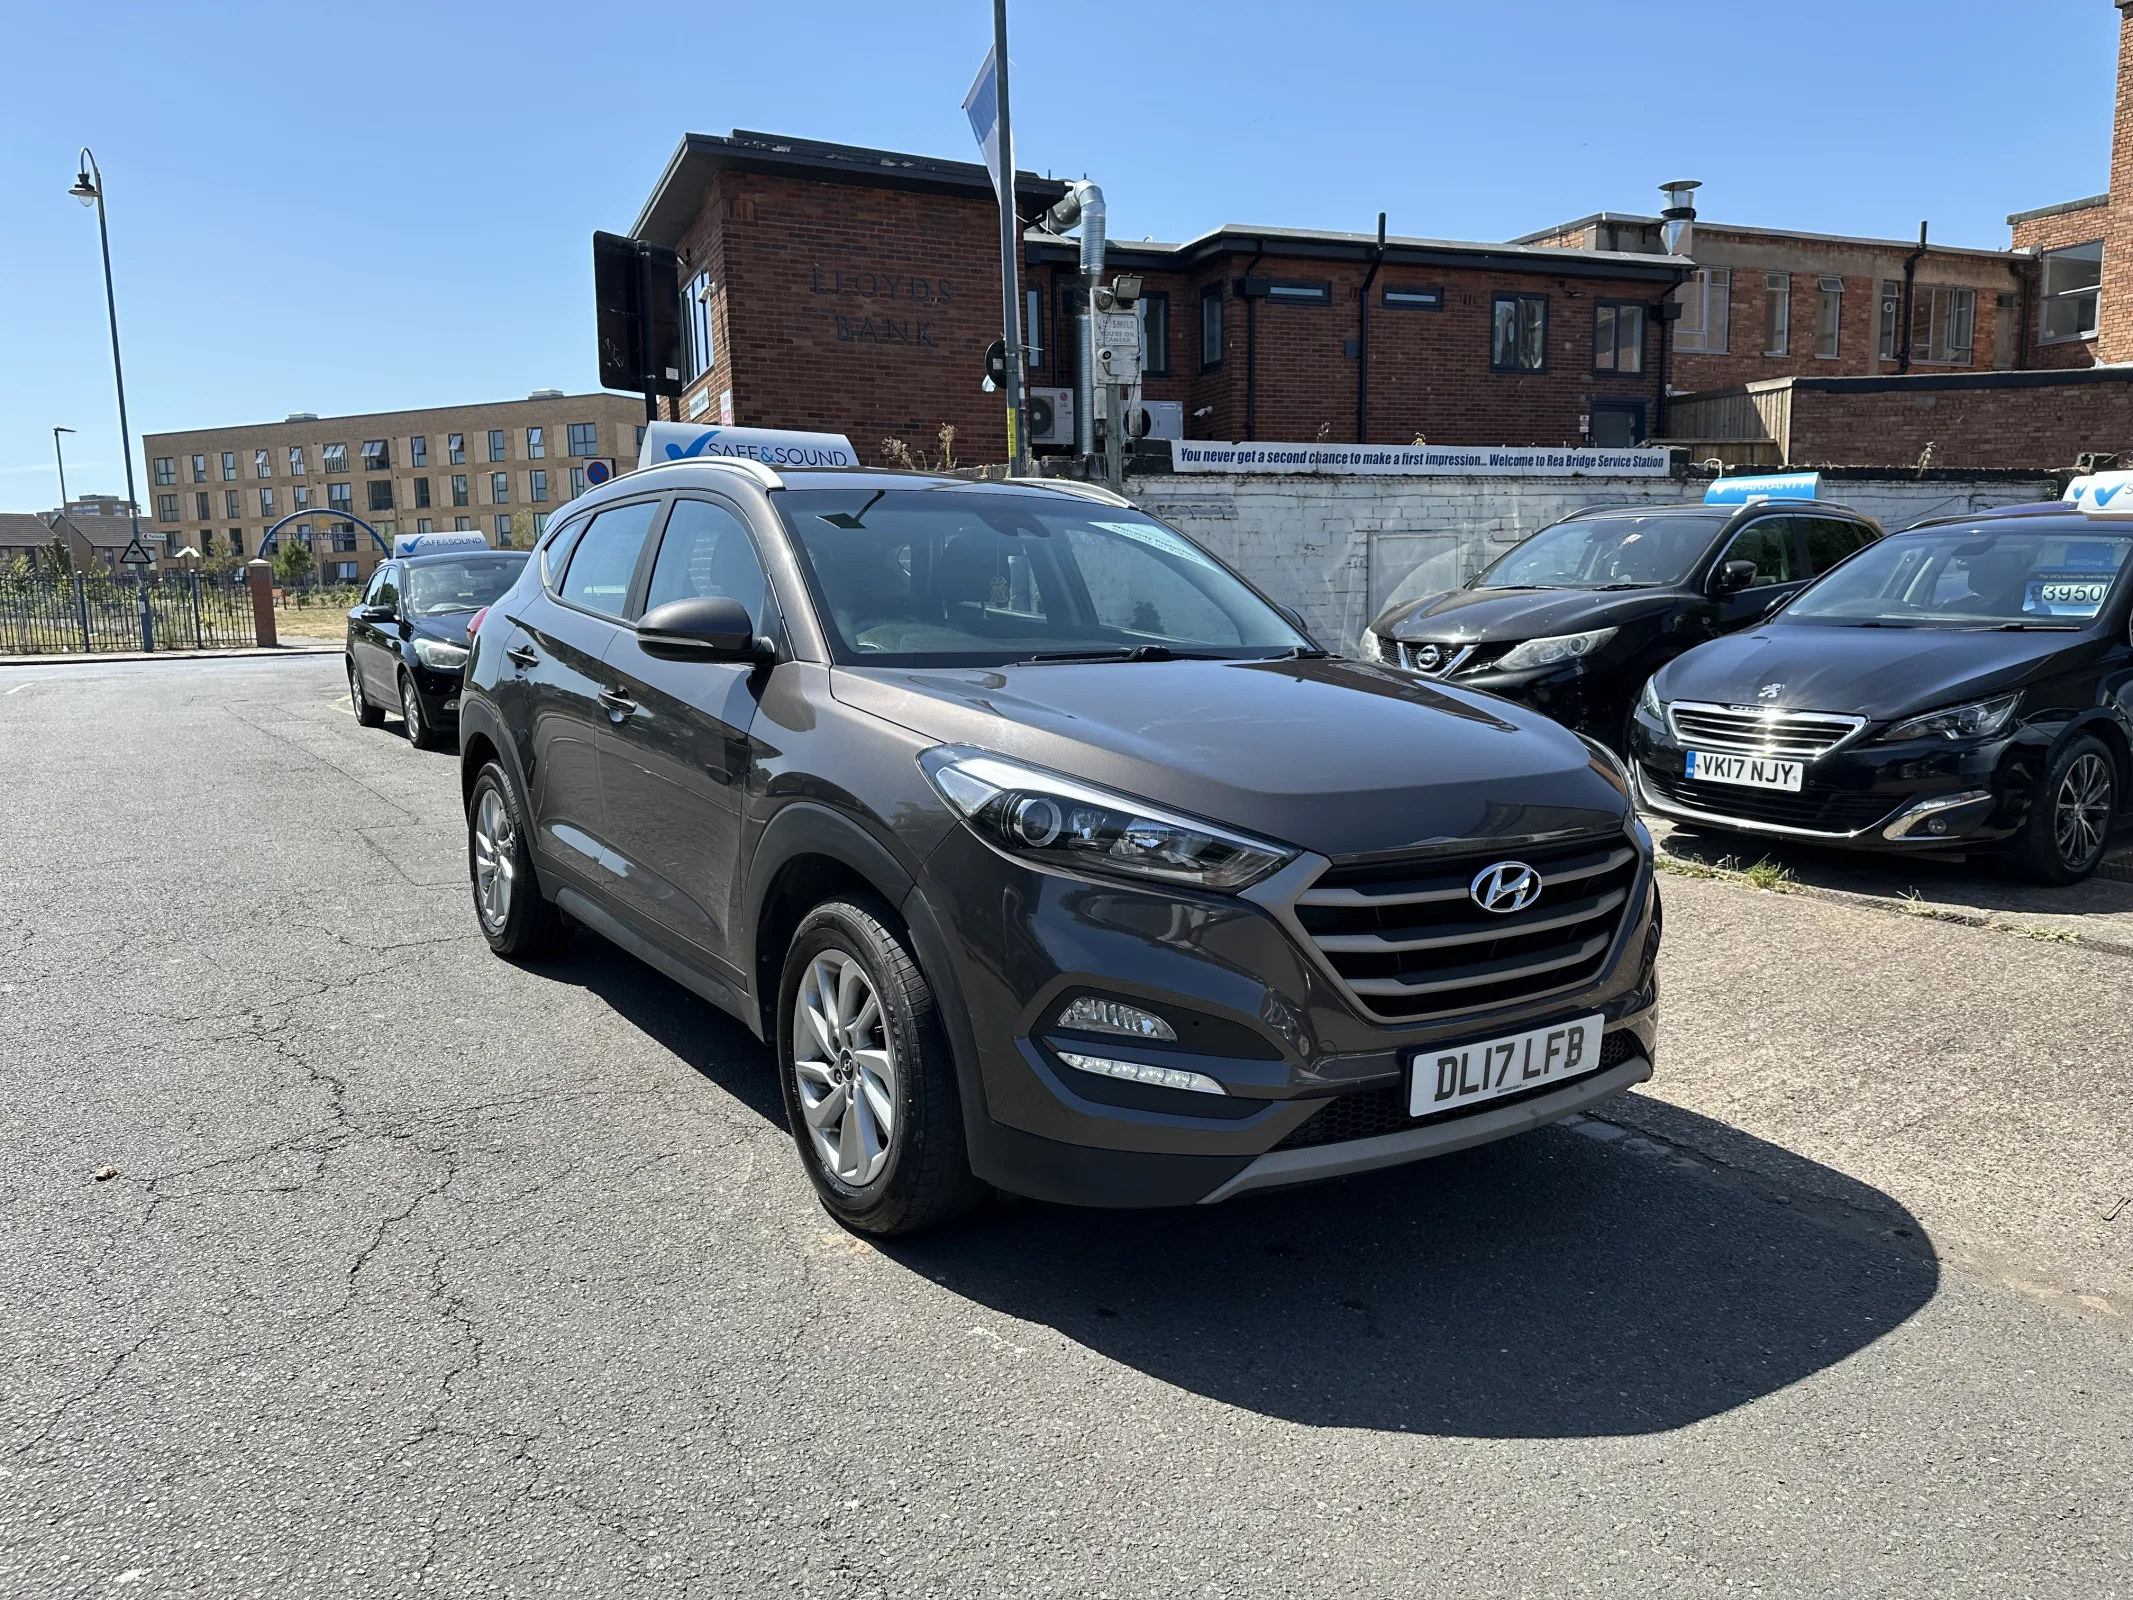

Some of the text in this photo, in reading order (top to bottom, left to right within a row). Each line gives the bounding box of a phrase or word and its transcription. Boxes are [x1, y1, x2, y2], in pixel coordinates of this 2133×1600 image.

[813, 264, 951, 304] LLOYDS
[836, 315, 939, 348] BANK
[1112, 320, 1134, 329] SMILE
[708, 443, 847, 466] SAFE&SOUND
[1181, 447, 1200, 461] You
[1203, 449, 1235, 462] never
[1237, 450, 1256, 464] get
[1258, 452, 1264, 463] a
[1267, 451, 1306, 463] second
[1309, 451, 1348, 464] chance
[1350, 452, 1360, 464] to
[1363, 452, 1391, 464] make
[1393, 454, 1399, 464] a
[1401, 453, 1424, 465] first
[1489, 454, 1533, 467] Welcome
[1535, 454, 1545, 467] to
[1547, 454, 1563, 467] Rea
[1565, 454, 1596, 468] Bridge
[1597, 455, 1631, 467] Service
[1632, 455, 1664, 468] Station
[419, 537, 482, 547] SAFE&SOUND
[1703, 755, 1794, 785] VK17 NJY
[1434, 1025, 1585, 1101] DL17 LFB
